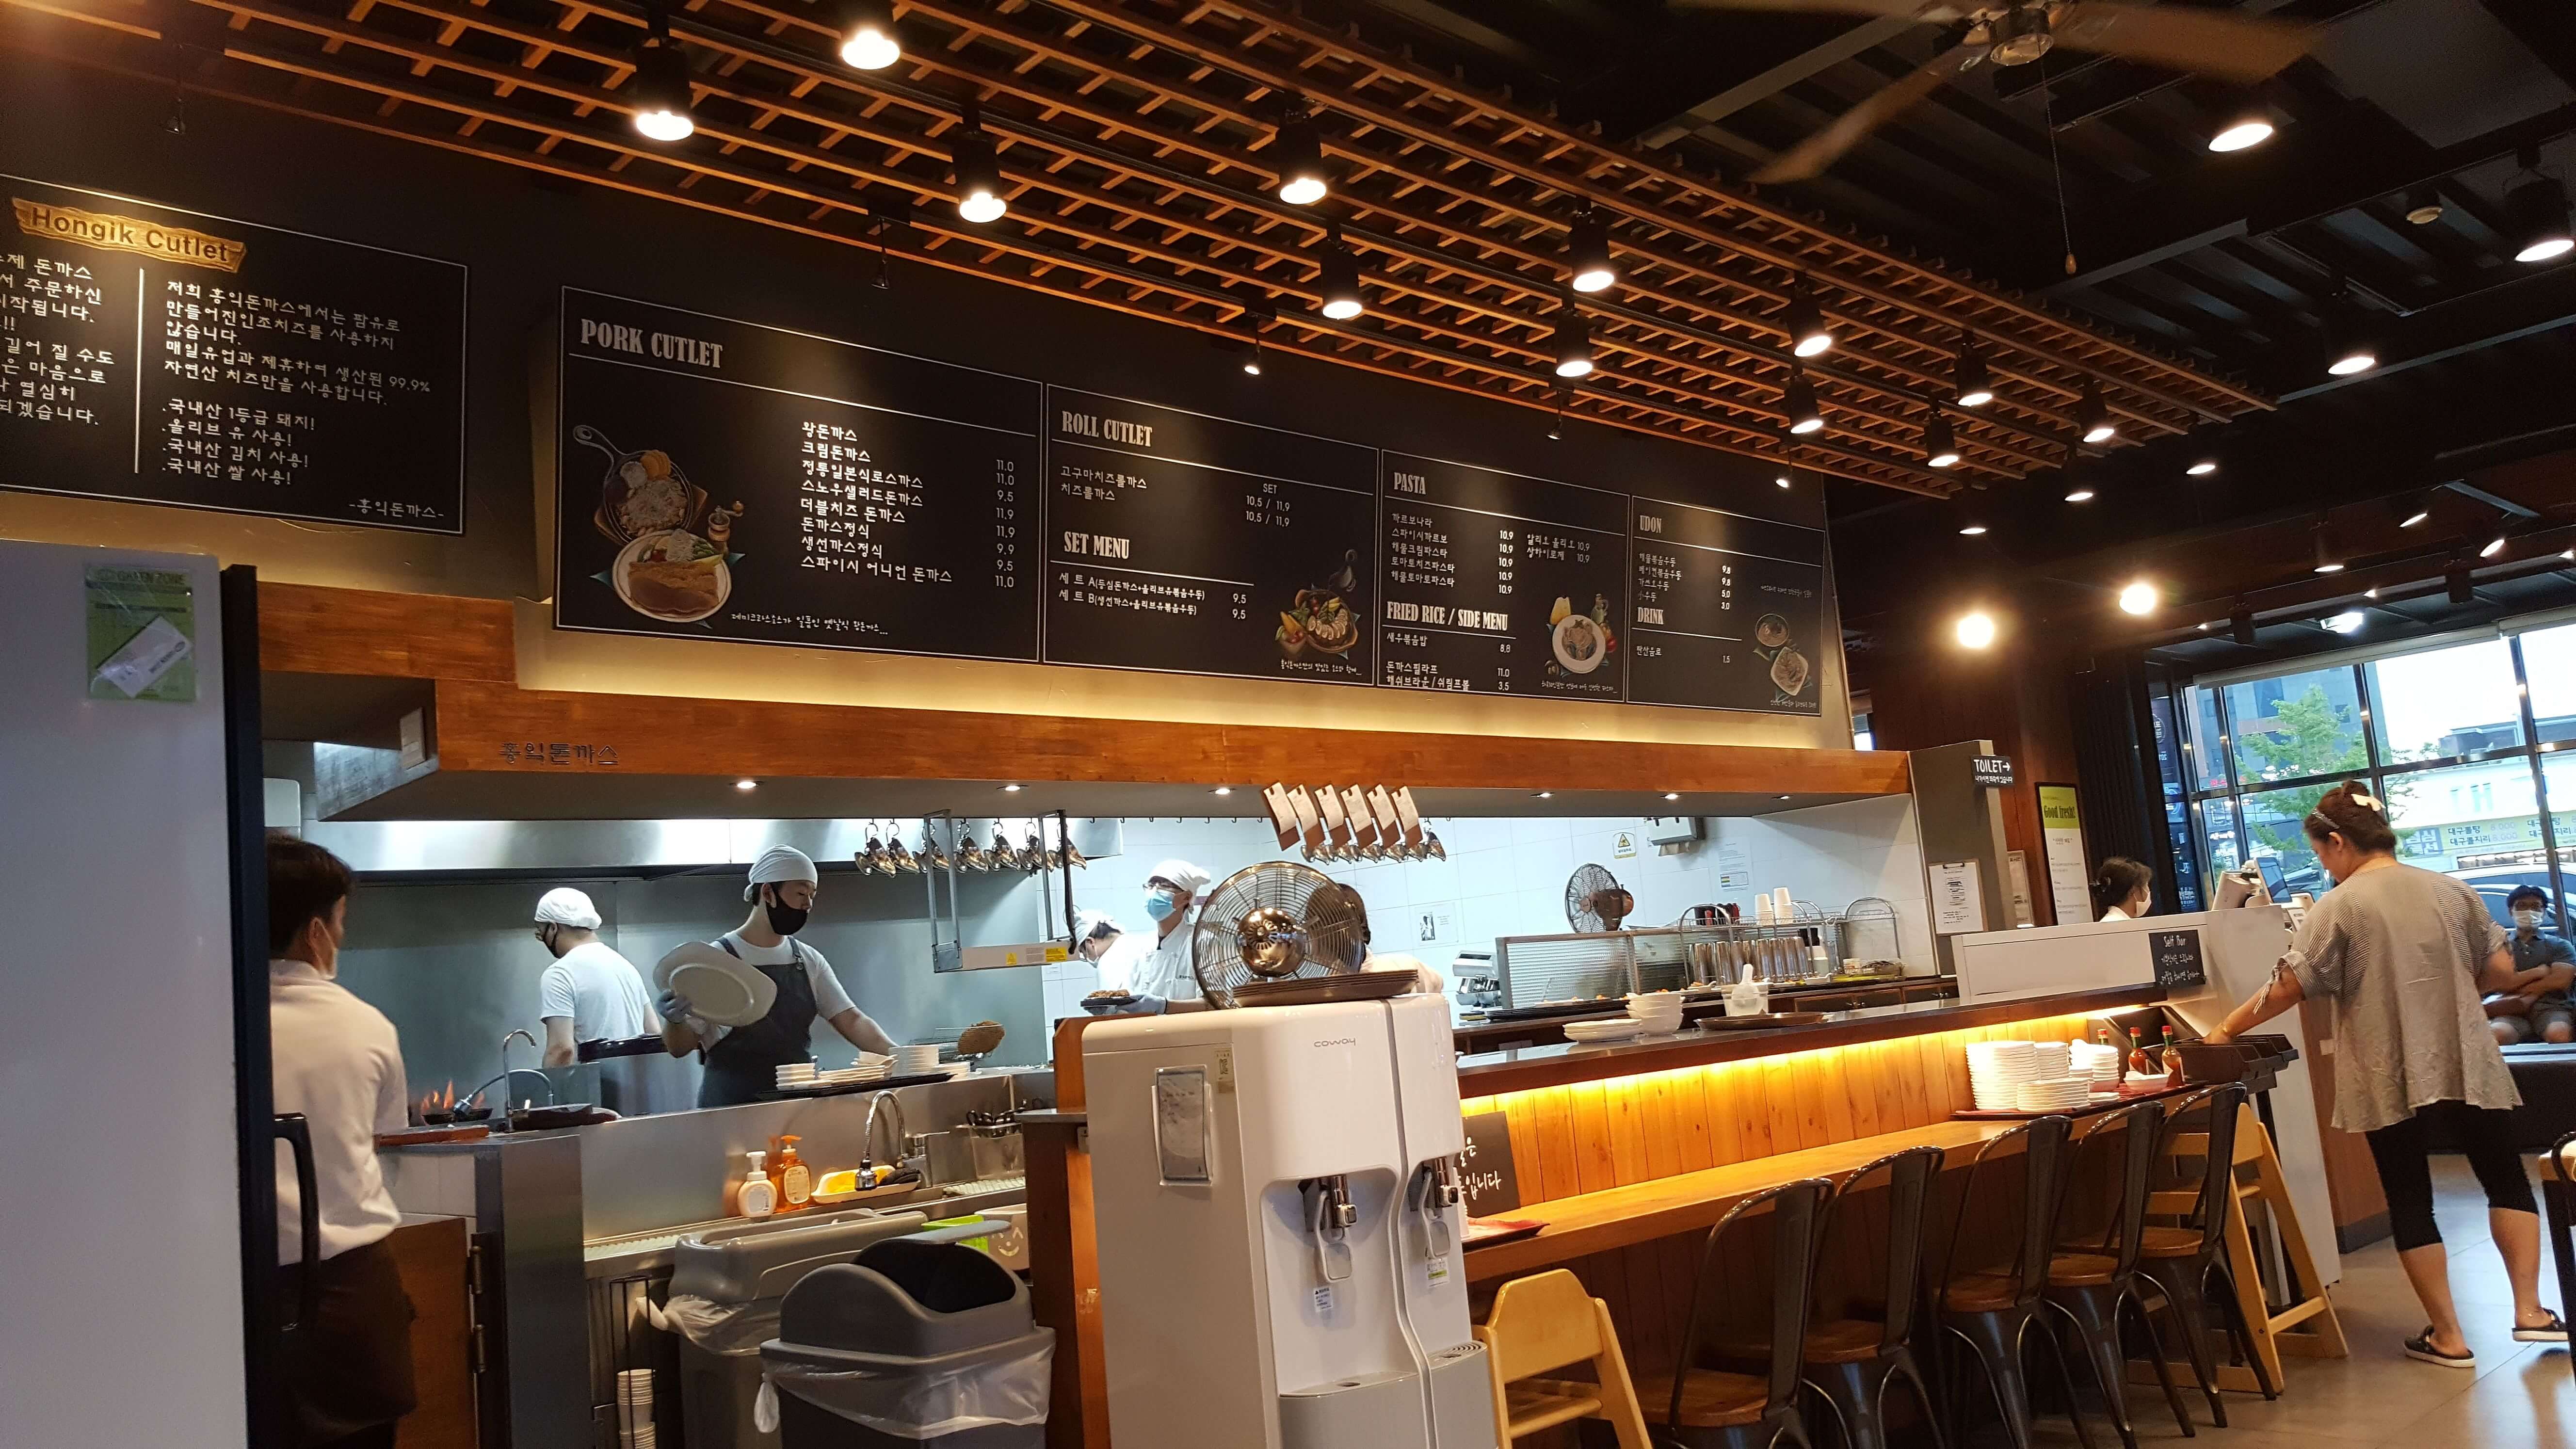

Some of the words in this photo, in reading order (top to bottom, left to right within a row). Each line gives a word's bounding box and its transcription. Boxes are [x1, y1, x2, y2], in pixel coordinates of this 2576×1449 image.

[32, 207, 134, 244] Hongik
[146, 229, 227, 261] Cutlet
[34, 258, 93, 280] 돈까스
[24, 278, 101, 306] 주문하신
[167, 281, 200, 299] 저희
[209, 288, 346, 325] 홍익돈까스에서는
[353, 313, 400, 332] 팜유로
[166, 318, 241, 345] 않습니다.
[330, 329, 393, 350] 사용하지
[4, 337, 40, 355] 길어
[52, 344, 68, 361] 질
[77, 348, 114, 364] 수도
[580, 319, 644, 354] PORK
[651, 332, 723, 369] CUTLET
[30, 362, 106, 384] 마음으로
[166, 340, 255, 366] 매일유업과
[261, 355, 326, 377] 제휴하여
[336, 367, 382, 387] 생산된
[389, 376, 430, 392] 99.9%
[20, 381, 74, 401] 열심히
[164, 360, 219, 382] 자연산
[226, 369, 293, 393] 치즈만을
[301, 379, 386, 405] 사용합니다.
[228, 407, 269, 425] 1등급
[276, 413, 314, 431] 돼지!
[228, 426, 245, 440] 유
[252, 429, 291, 447] 사용!
[802, 421, 857, 442] 왕돈까스
[1062, 411, 1099, 437] ROLL
[1104, 419, 1153, 447] CUTLET
[230, 446, 260, 462] 김치
[269, 451, 308, 468] 사용!
[802, 441, 871, 462] 크림돈까스
[997, 459, 1014, 472] 11.0
[228, 465, 245, 481] 쌀
[251, 468, 290, 485] 사용!
[802, 460, 923, 489] 정통일본식로스까스
[996, 473, 1014, 485] 11.0
[1061, 466, 1147, 490] 고구마치즈롤까스
[1061, 483, 1115, 500] 치즈롤까스
[1263, 483, 1277, 494] SET
[1394, 472, 1426, 495] PASTA
[801, 479, 923, 507] 스노우샐러드돈까스
[997, 489, 1014, 502] 9.5
[801, 498, 858, 517] 더블치즈
[864, 506, 905, 523] 돈까스
[1246, 495, 1262, 507] 10.5
[1276, 500, 1290, 512] 11.9
[996, 507, 1014, 520] 11.9
[1246, 511, 1262, 522] 10.5
[1276, 515, 1290, 527] 11.9
[1392, 513, 1433, 528] 까르보나라
[801, 516, 869, 539] 돈까스정식
[997, 525, 1015, 538] 11.9
[1640, 515, 1662, 533] UDON
[1391, 528, 1448, 544] 스파이시까르보
[1500, 530, 1513, 540] 10.9
[1527, 534, 1549, 546] 알리오
[1552, 537, 1576, 548] 올리오
[1577, 542, 1590, 551] 10.9
[802, 536, 882, 559] 생선까스정식
[997, 543, 1014, 555] 9.9
[1064, 531, 1089, 554] SET
[1093, 535, 1130, 559] MENU
[1391, 542, 1448, 559] 해물크림파스타
[1499, 543, 1513, 554] 10.9
[997, 559, 1013, 571] 9.5
[1391, 556, 1455, 574] 토마토치즈파스타
[1498, 557, 1513, 567] 10.9
[1577, 553, 1590, 563] 10.9
[801, 556, 858, 574] 스파이시
[867, 562, 906, 580] 어니언
[912, 567, 952, 582] 돈까스
[1498, 571, 1513, 580] 10.9
[1722, 565, 1731, 574] 9.8
[995, 575, 1014, 588] 11.0
[1391, 570, 1455, 588] 해물토마토파스타
[1722, 577, 1731, 586] 9.8
[1498, 584, 1512, 594] 10.9
[1722, 590, 1730, 598] 5.0
[1233, 593, 1246, 604] 9.5
[1721, 602, 1730, 610] 3.0
[1232, 609, 1246, 620] 9.5
[1386, 601, 1418, 621] FRIED
[1421, 605, 1445, 625] RICE
[1458, 609, 1481, 628] SIDE
[1482, 612, 1508, 631] MENU
[1637, 607, 1664, 625] DRINK
[1386, 632, 1428, 647] 새우볶음밥
[1500, 644, 1511, 653] 8.8
[1386, 661, 1438, 675] 돈까스필라프
[1497, 667, 1510, 677] 11.0
[1498, 681, 1510, 691] 3.5
[500, 742, 619, 765] 홍익돈까스
[1974, 759, 2002, 773] TOILET
[2044, 805, 2058, 818] Good
[1314, 1037, 1356, 1047] coway
